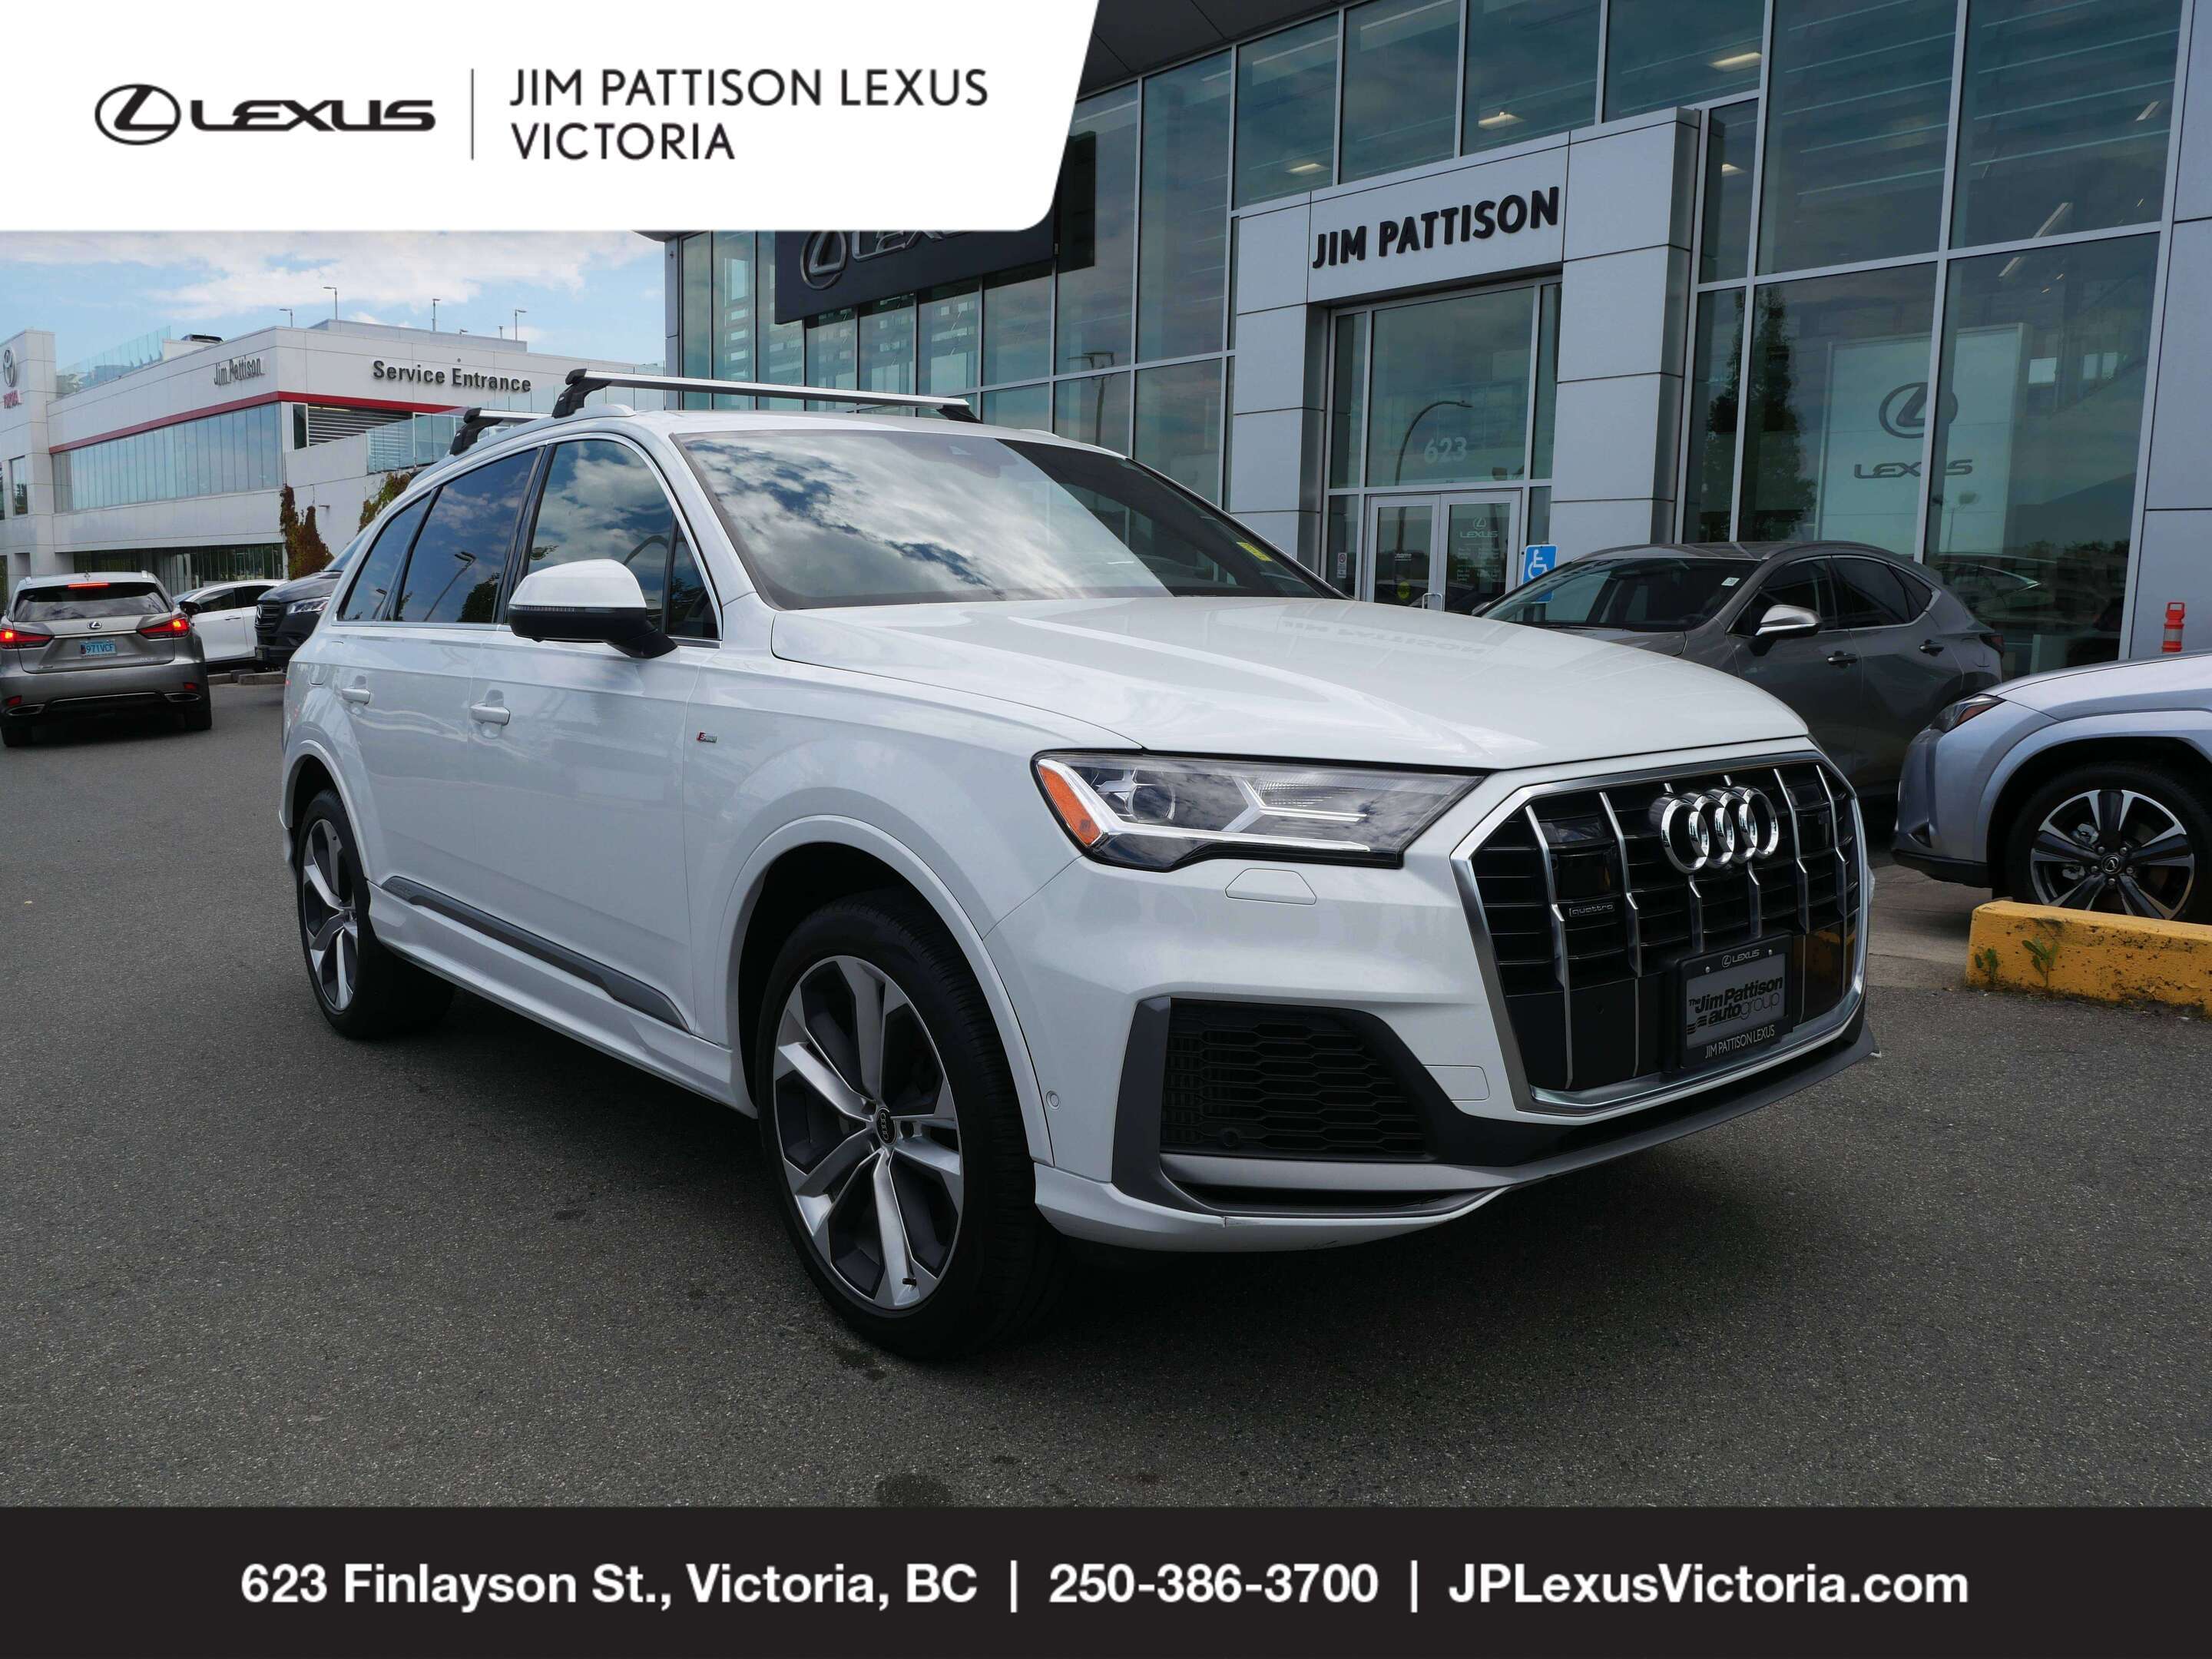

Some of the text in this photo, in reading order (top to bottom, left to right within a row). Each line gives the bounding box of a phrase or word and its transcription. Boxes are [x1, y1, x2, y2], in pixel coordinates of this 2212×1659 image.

[1312, 186, 1560, 269] JIM PATTISON
[214, 354, 262, 386] Jim Pattison
[373, 359, 532, 392] Service Entrance
[1424, 436, 1468, 464] 623
[1854, 459, 1973, 479] LEXS
[1459, 530, 1499, 538] LEXUS
[1571, 904, 1614, 916] quattro
[1732, 949, 1760, 964] LEXUS
[1704, 1024, 1776, 1059] JIM PATTISON LEXUS
